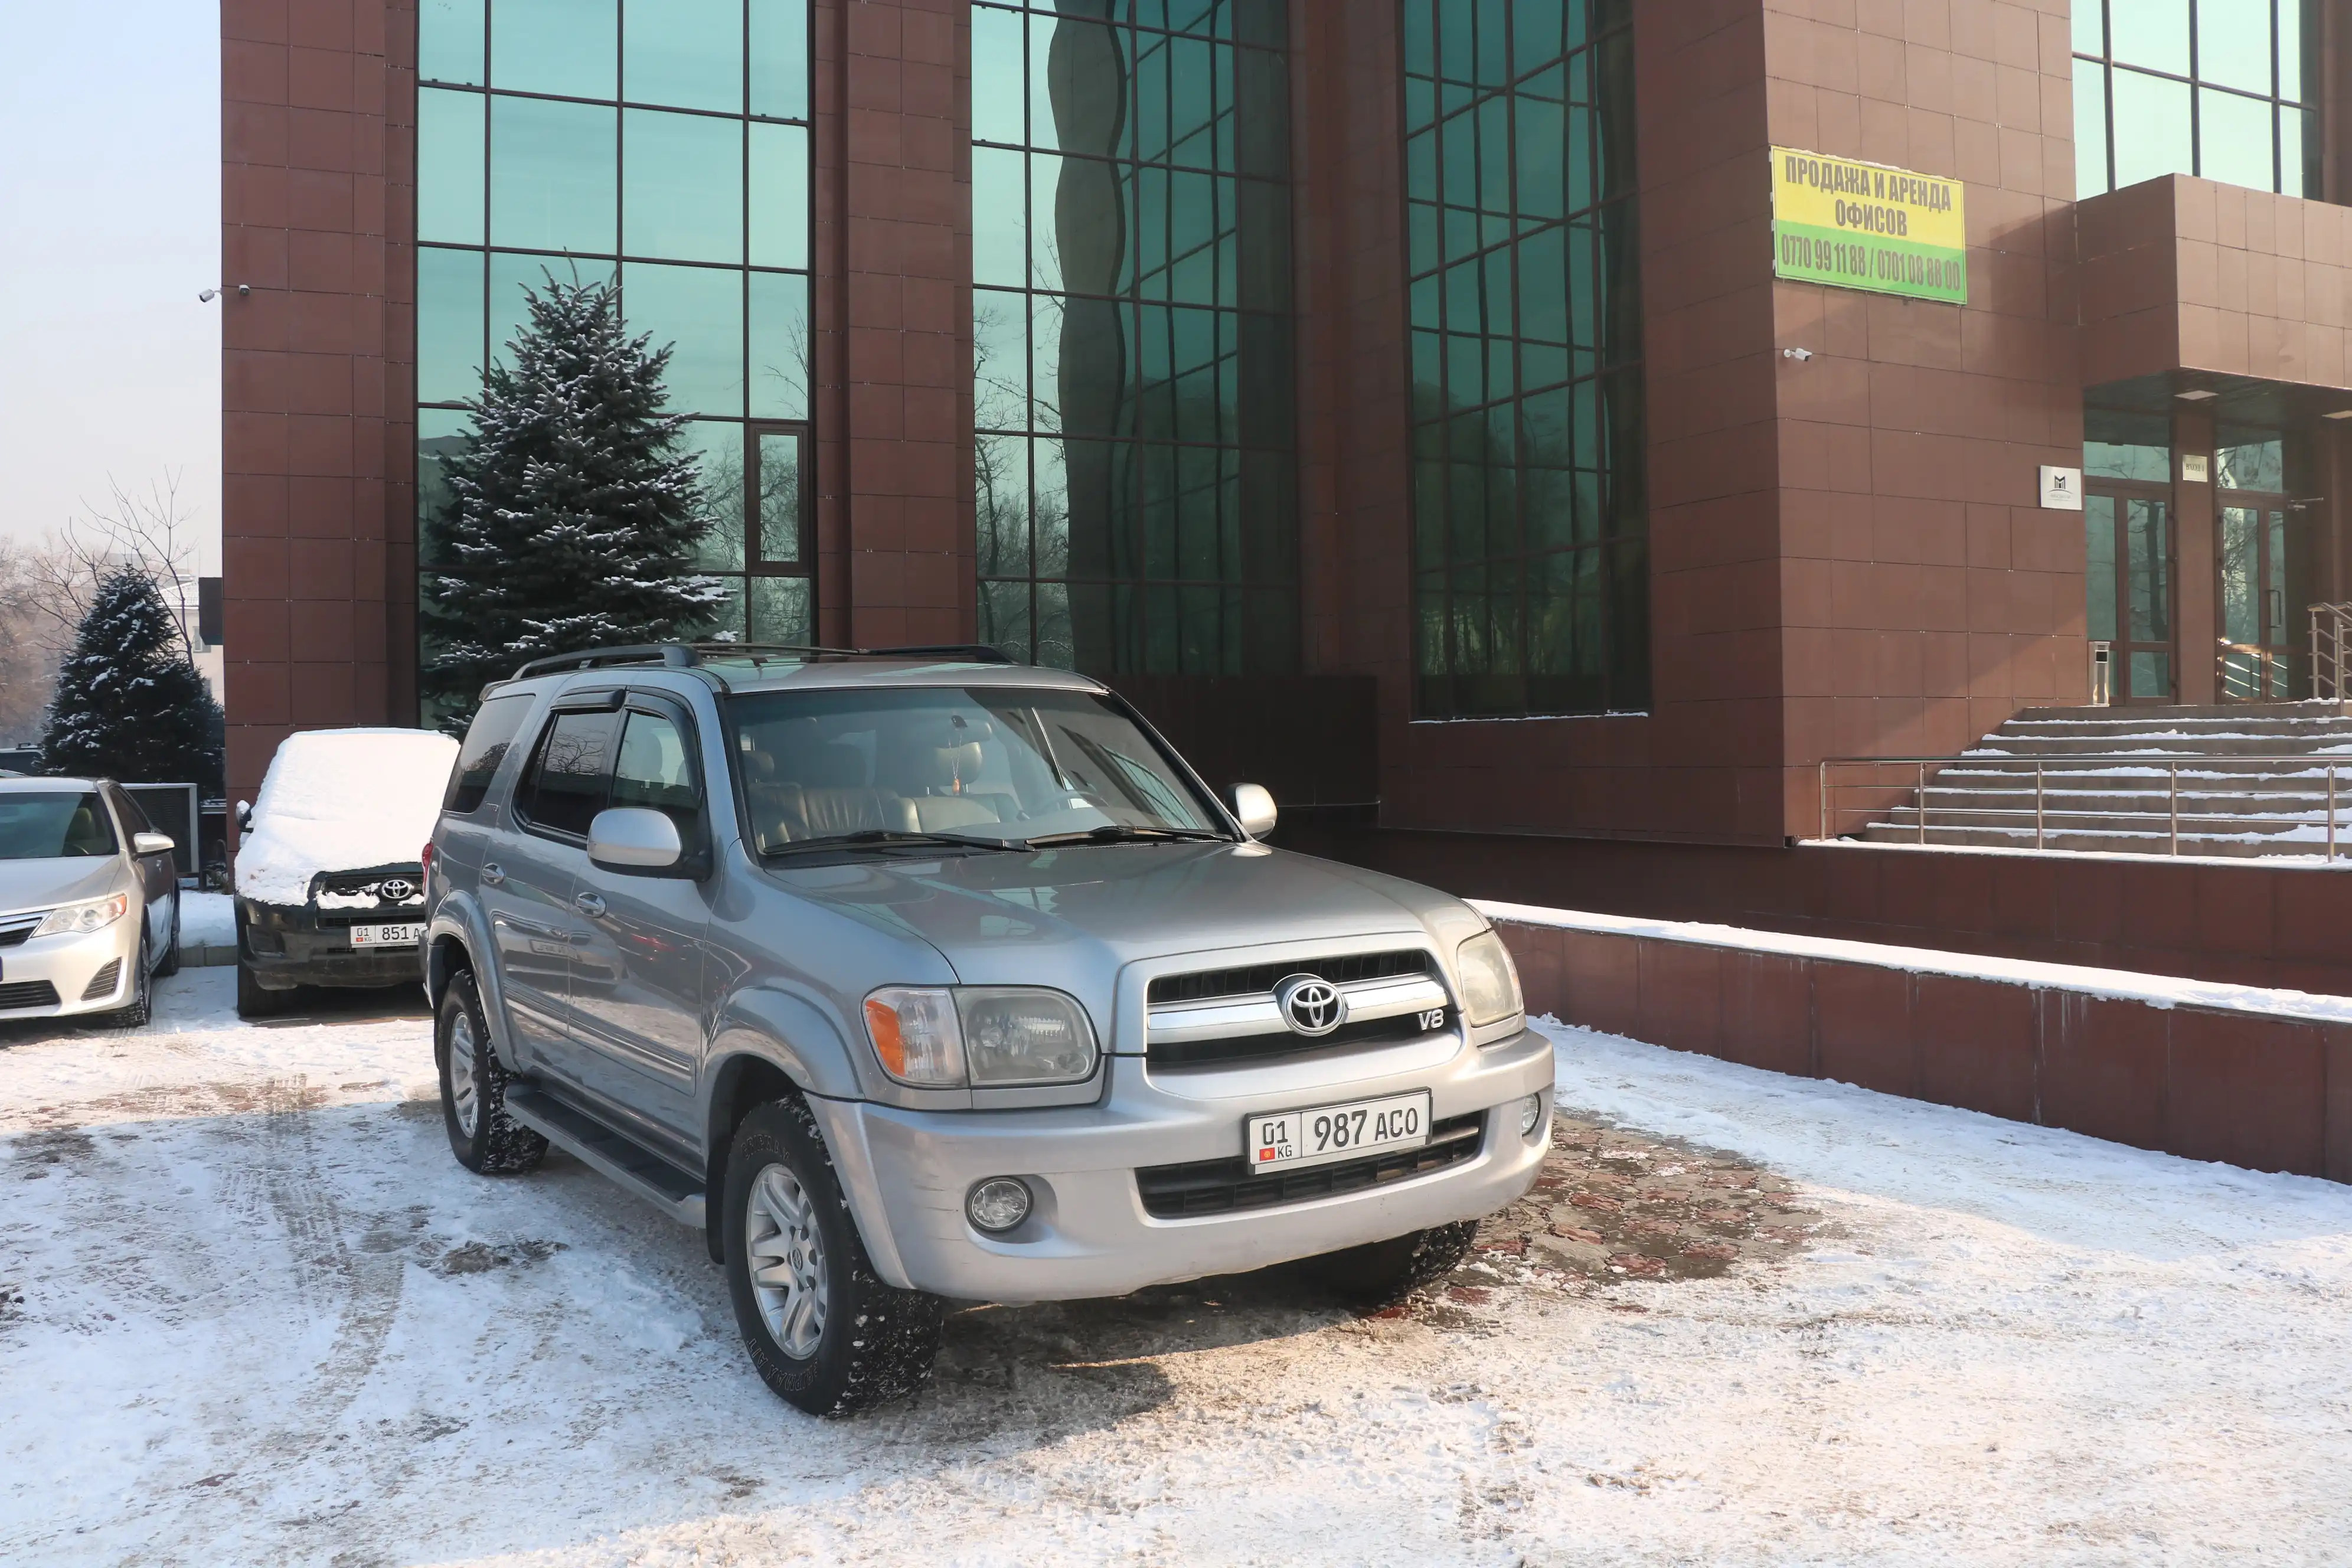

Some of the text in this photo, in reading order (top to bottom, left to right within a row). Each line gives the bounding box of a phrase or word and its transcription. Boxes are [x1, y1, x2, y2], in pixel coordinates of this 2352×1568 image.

[1785, 155, 1951, 213] ПРОДАЖА И АРЕНДА
[1835, 199, 1907, 236] ОФИСОВ
[1781, 234, 1811, 269] 0770
[1815, 239, 1831, 271] 99
[1834, 242, 1847, 273] 11
[1849, 244, 1866, 276] 88
[1877, 249, 1905, 282] 0701
[1908, 252, 1924, 286] 08
[1927, 257, 1942, 288] 88
[1945, 260, 1961, 292] 00
[357, 927, 370, 936] 01
[382, 926, 409, 940] 851
[1418, 1009, 1444, 1031] V8
[1263, 1121, 1288, 1145] 01
[1314, 1109, 1367, 1151] 987
[1278, 1145, 1292, 1159] KG
